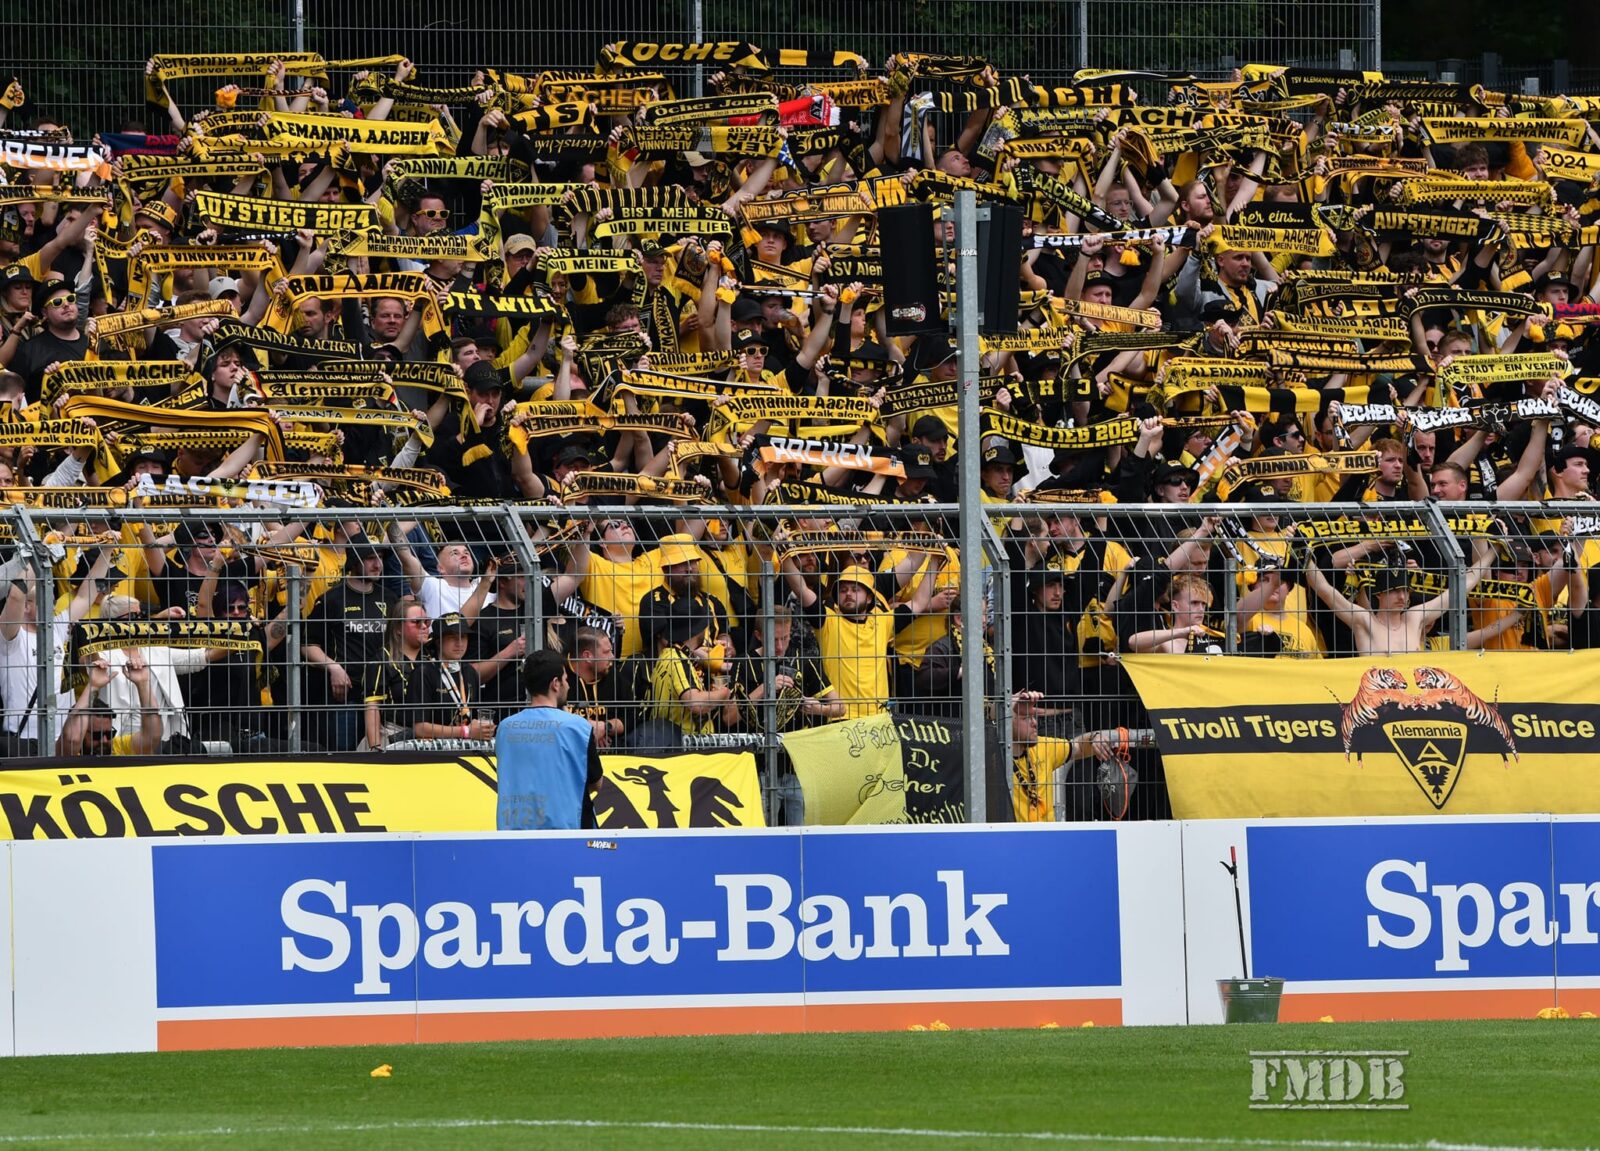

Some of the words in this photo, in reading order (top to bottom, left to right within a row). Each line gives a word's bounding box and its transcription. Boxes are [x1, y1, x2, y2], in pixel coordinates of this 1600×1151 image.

[152, 56, 236, 71] Alemannia
[193, 66, 228, 74] never
[1347, 82, 1459, 106] Alemannia
[655, 102, 712, 117] Öcher
[719, 98, 778, 108] Jong
[1431, 119, 1481, 129] EINMAL
[268, 121, 361, 144] ALEMANNIA
[366, 128, 430, 146] AACHEN
[637, 131, 693, 141] AACHEN
[1493, 129, 1568, 141] ALEMANNIA
[638, 140, 693, 151] ALEMANNIA
[727, 141, 775, 152] AEK
[0, 140, 105, 169] ACHEN
[1543, 150, 1588, 171] 2024
[128, 167, 208, 178] LEMANNIA
[511, 195, 546, 205] never
[1035, 173, 1092, 212] AACHEN
[315, 209, 370, 229] 2024
[621, 206, 652, 218] BIST
[661, 206, 698, 218] MEIN
[609, 220, 637, 234] UND
[643, 219, 690, 232] MEINE
[697, 219, 729, 232] LIEB
[1374, 211, 1480, 236] AUFSTEIGER
[1221, 225, 1276, 241] ALEMANNIA
[1283, 228, 1322, 244] AACHEN
[1412, 228, 1438, 237] 2024
[367, 234, 426, 246] ALEMANNIA
[428, 235, 468, 248] AACHEN
[1273, 242, 1293, 250] MEIN
[1294, 245, 1321, 254] VEREIN
[173, 250, 253, 264] ALEMANNIA
[367, 244, 392, 253] MEINE
[392, 244, 419, 255] STADT,
[420, 246, 441, 256] MEIN
[441, 247, 468, 256] VEREIN
[573, 259, 618, 271] MEINE
[288, 274, 334, 295] BAD
[1415, 289, 1450, 307] Jahre
[1456, 293, 1534, 311] Alemannia
[1322, 325, 1351, 335] never
[1355, 327, 1380, 336] walk
[214, 323, 299, 348] ALEMANNIA
[301, 338, 357, 355] AACHEN
[1031, 341, 1048, 350] MEIN
[390, 364, 445, 383] AACHEN
[693, 363, 717, 373] walk
[1463, 364, 1495, 374] STADT
[1505, 363, 1523, 372] EIN
[261, 373, 276, 381] WIR
[277, 373, 301, 381] HABEN
[302, 373, 322, 382] NOCH
[322, 374, 350, 382] LANGE
[350, 374, 372, 382] NICHT
[271, 382, 386, 398] Alemannia
[883, 384, 955, 402] ALEMANNIA
[728, 396, 810, 413] Alemannia
[813, 396, 873, 413] Aachen
[892, 392, 958, 411] AUFSTEIGE
[769, 410, 802, 419] never
[806, 409, 834, 418] walk
[837, 410, 869, 419] alone
[989, 413, 1091, 444] AUFSTIEG
[32, 434, 62, 444] walk
[769, 436, 873, 469] AACHEN
[383, 467, 441, 487] AACHEN
[1224, 460, 1309, 485] ALEMANNIA
[781, 482, 811, 500] TSV
[81, 621, 172, 640] DANKE
[179, 621, 253, 638] PAPA!
[505, 720, 562, 730] SECURITY
[1160, 715, 1241, 741] Tivoli
[1244, 713, 1337, 745] Tigers
[1512, 713, 1596, 739] Since
[1391, 723, 1462, 738] Alemannia
[506, 732, 556, 744] SERVICE
[840, 718, 951, 758] Fanclub
[907, 746, 940, 773] De
[0, 773, 388, 840] KÖLSCHE
[280, 869, 1011, 997] Sparda-Bank
